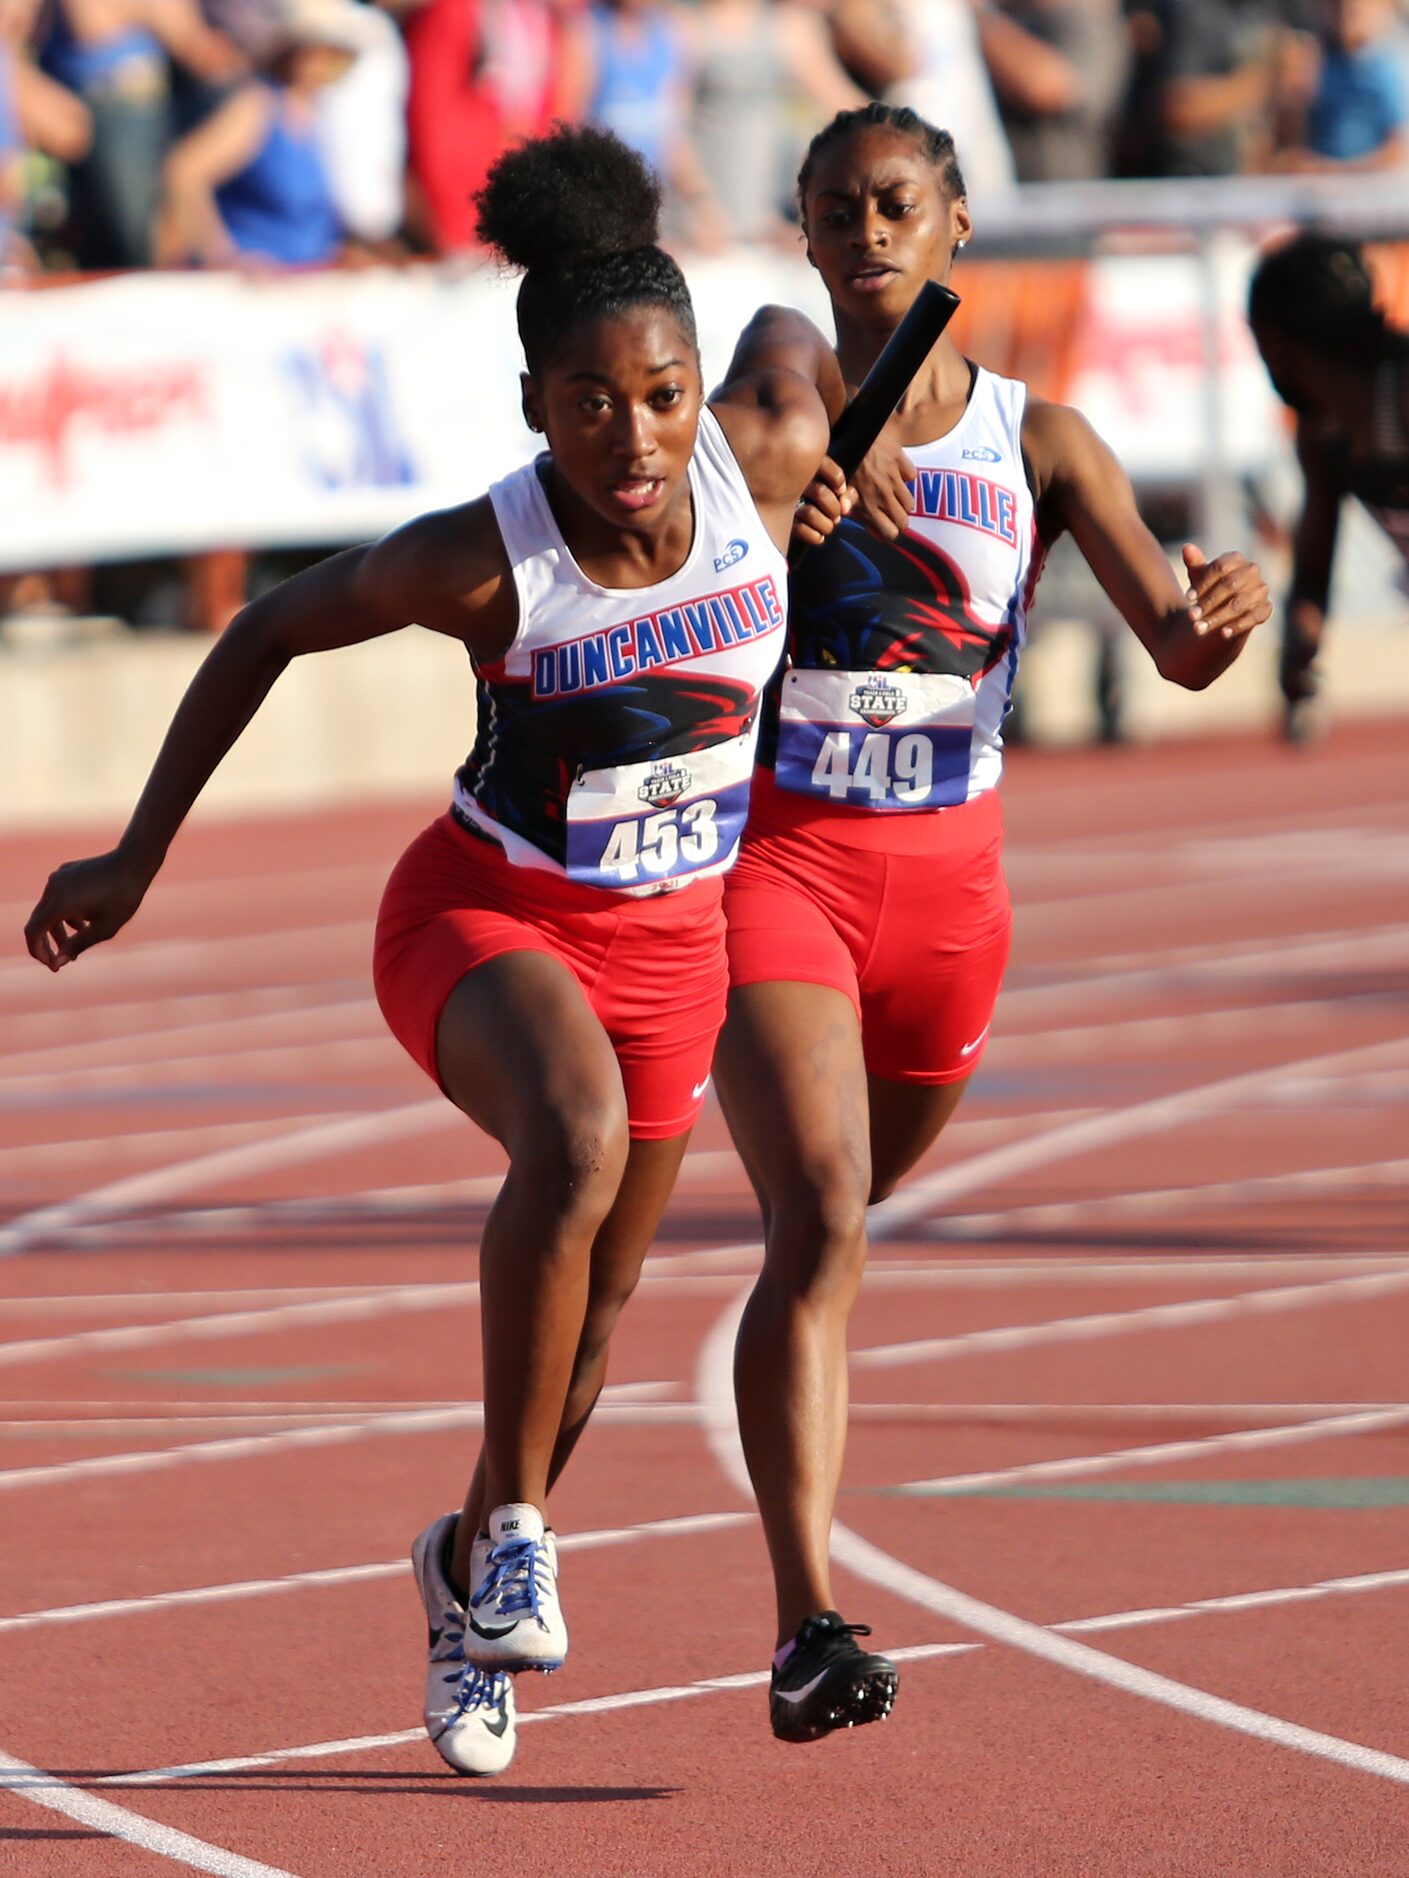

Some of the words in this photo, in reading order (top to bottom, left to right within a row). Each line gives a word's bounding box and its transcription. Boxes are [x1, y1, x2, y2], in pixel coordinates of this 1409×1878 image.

[961, 447, 996, 461] PCS
[906, 470, 1016, 543] VILLE
[713, 543, 744, 572] PCS
[533, 577, 783, 699] DUNCANVILLE
[850, 694, 907, 711] STATE
[812, 731, 934, 802] 449
[639, 776, 691, 799] STATE
[599, 799, 718, 880] 453
[500, 1518, 521, 1532] NIKE
